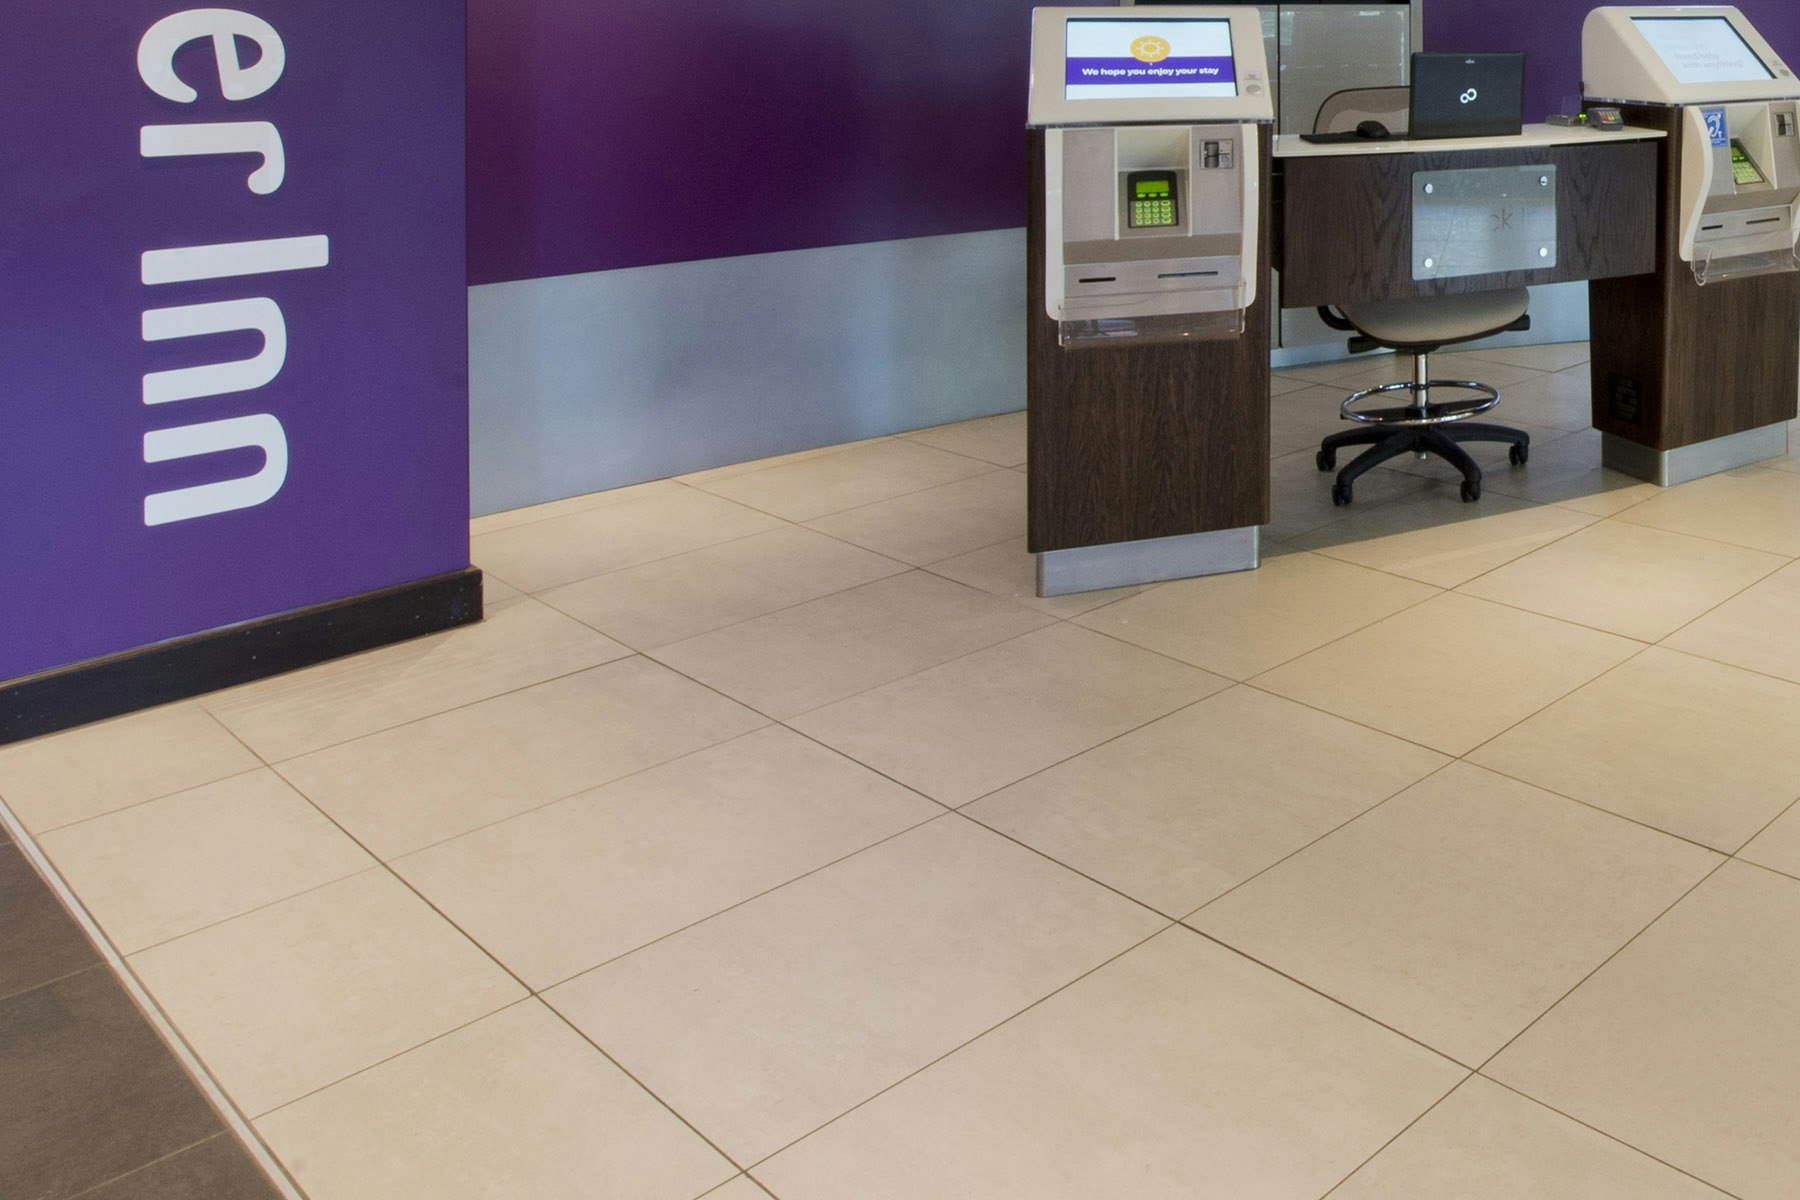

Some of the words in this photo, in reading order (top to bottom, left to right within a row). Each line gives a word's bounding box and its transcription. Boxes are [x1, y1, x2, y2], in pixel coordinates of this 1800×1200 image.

[1082, 68, 1099, 76] We
[1100, 68, 1126, 76] hope
[1127, 68, 1146, 77] you
[1147, 67, 1174, 77] enjoy
[1175, 67, 1197, 76] your
[1199, 67, 1219, 76] stay
[141, 234, 330, 527] Inn
